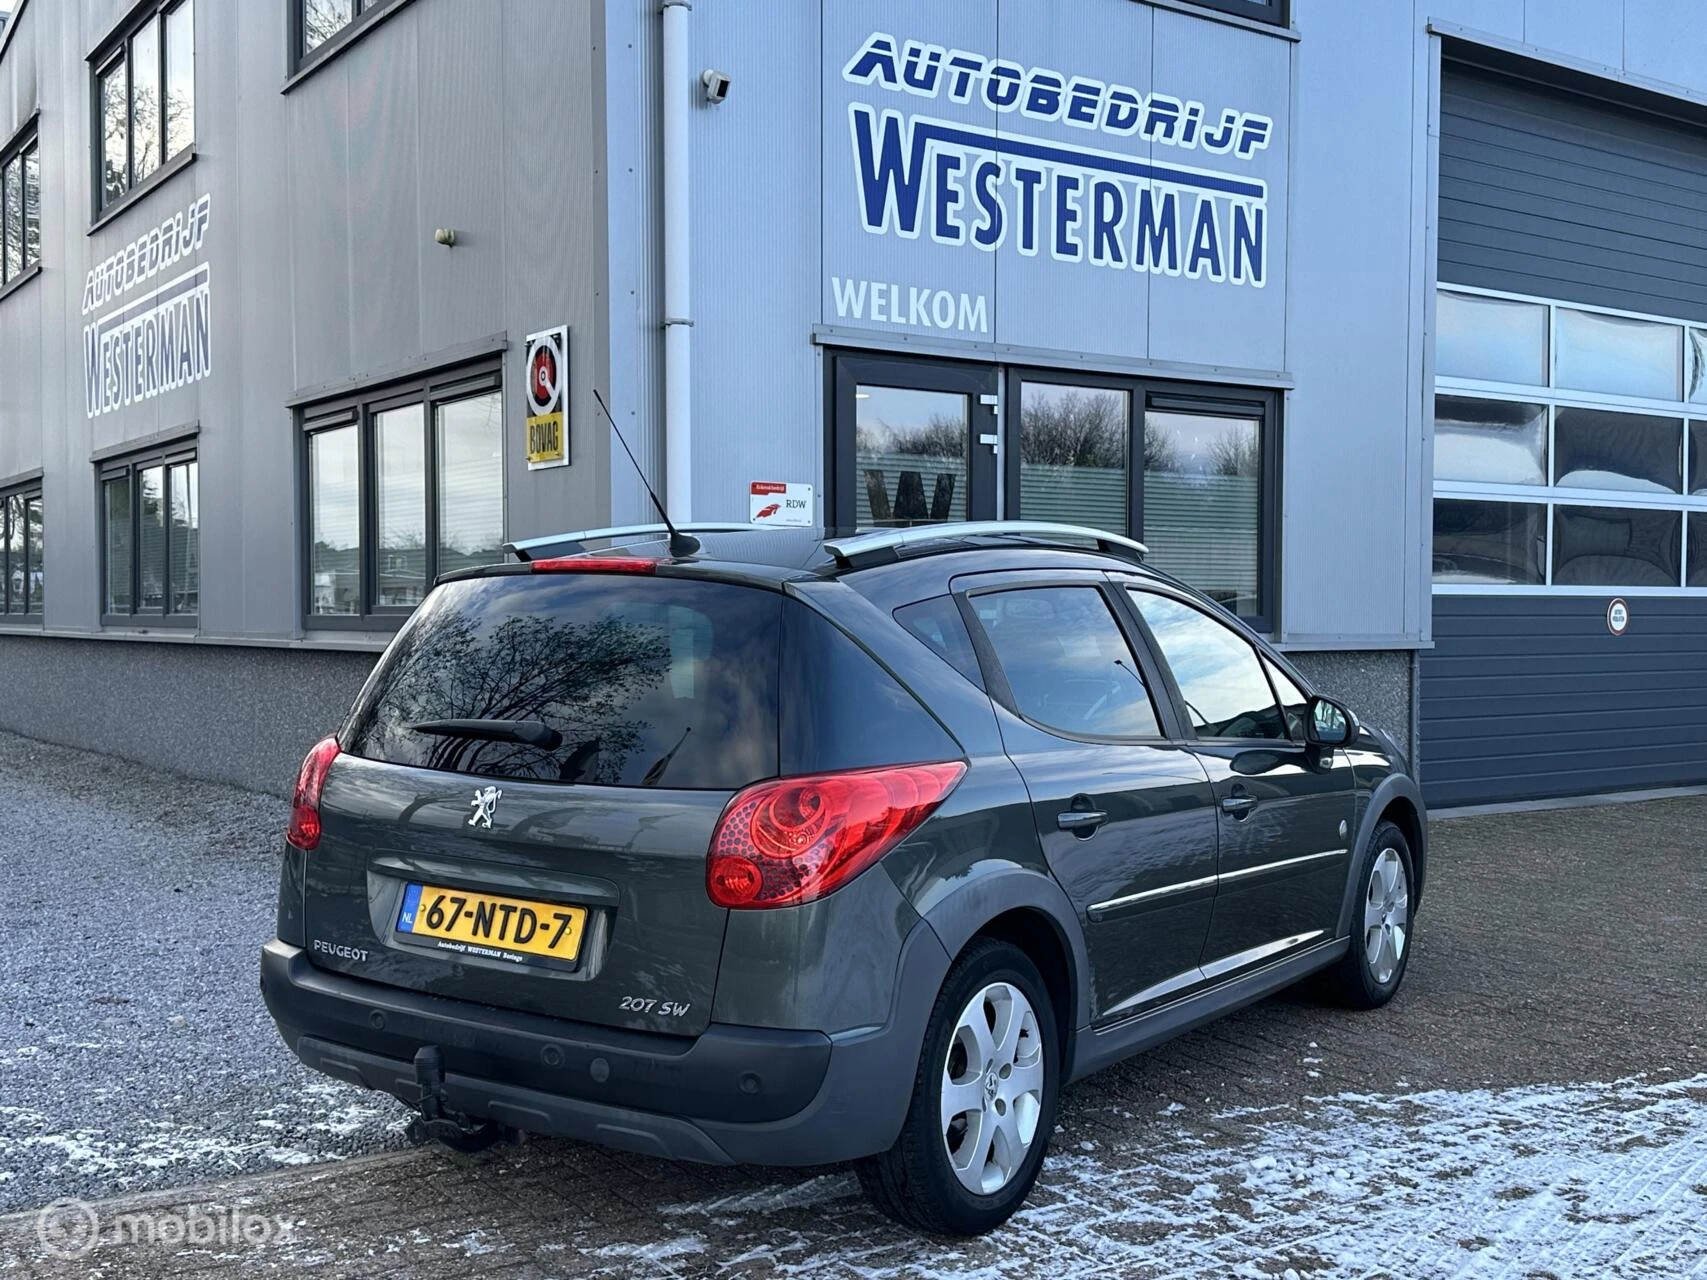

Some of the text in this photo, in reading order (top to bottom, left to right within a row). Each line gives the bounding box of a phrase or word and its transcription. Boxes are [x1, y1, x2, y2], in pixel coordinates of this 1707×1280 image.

[842, 32, 1273, 160] AUTOBEDRIJF
[848, 102, 1267, 288] WESTERMAN
[82, 193, 211, 315] AUTOBEDRIJF
[831, 276, 988, 333] WELKOM
[83, 262, 211, 418] WESTERMAN
[529, 420, 559, 454] BOVAG
[786, 499, 807, 509] RDW
[401, 911, 413, 924] NL
[426, 894, 572, 949] 67-NTD-7
[313, 939, 369, 962] PEUGEOT
[437, 940, 466, 953] Autobedrijf
[467, 945, 501, 958] WESTERMAN
[618, 995, 691, 1017] 207 SW
